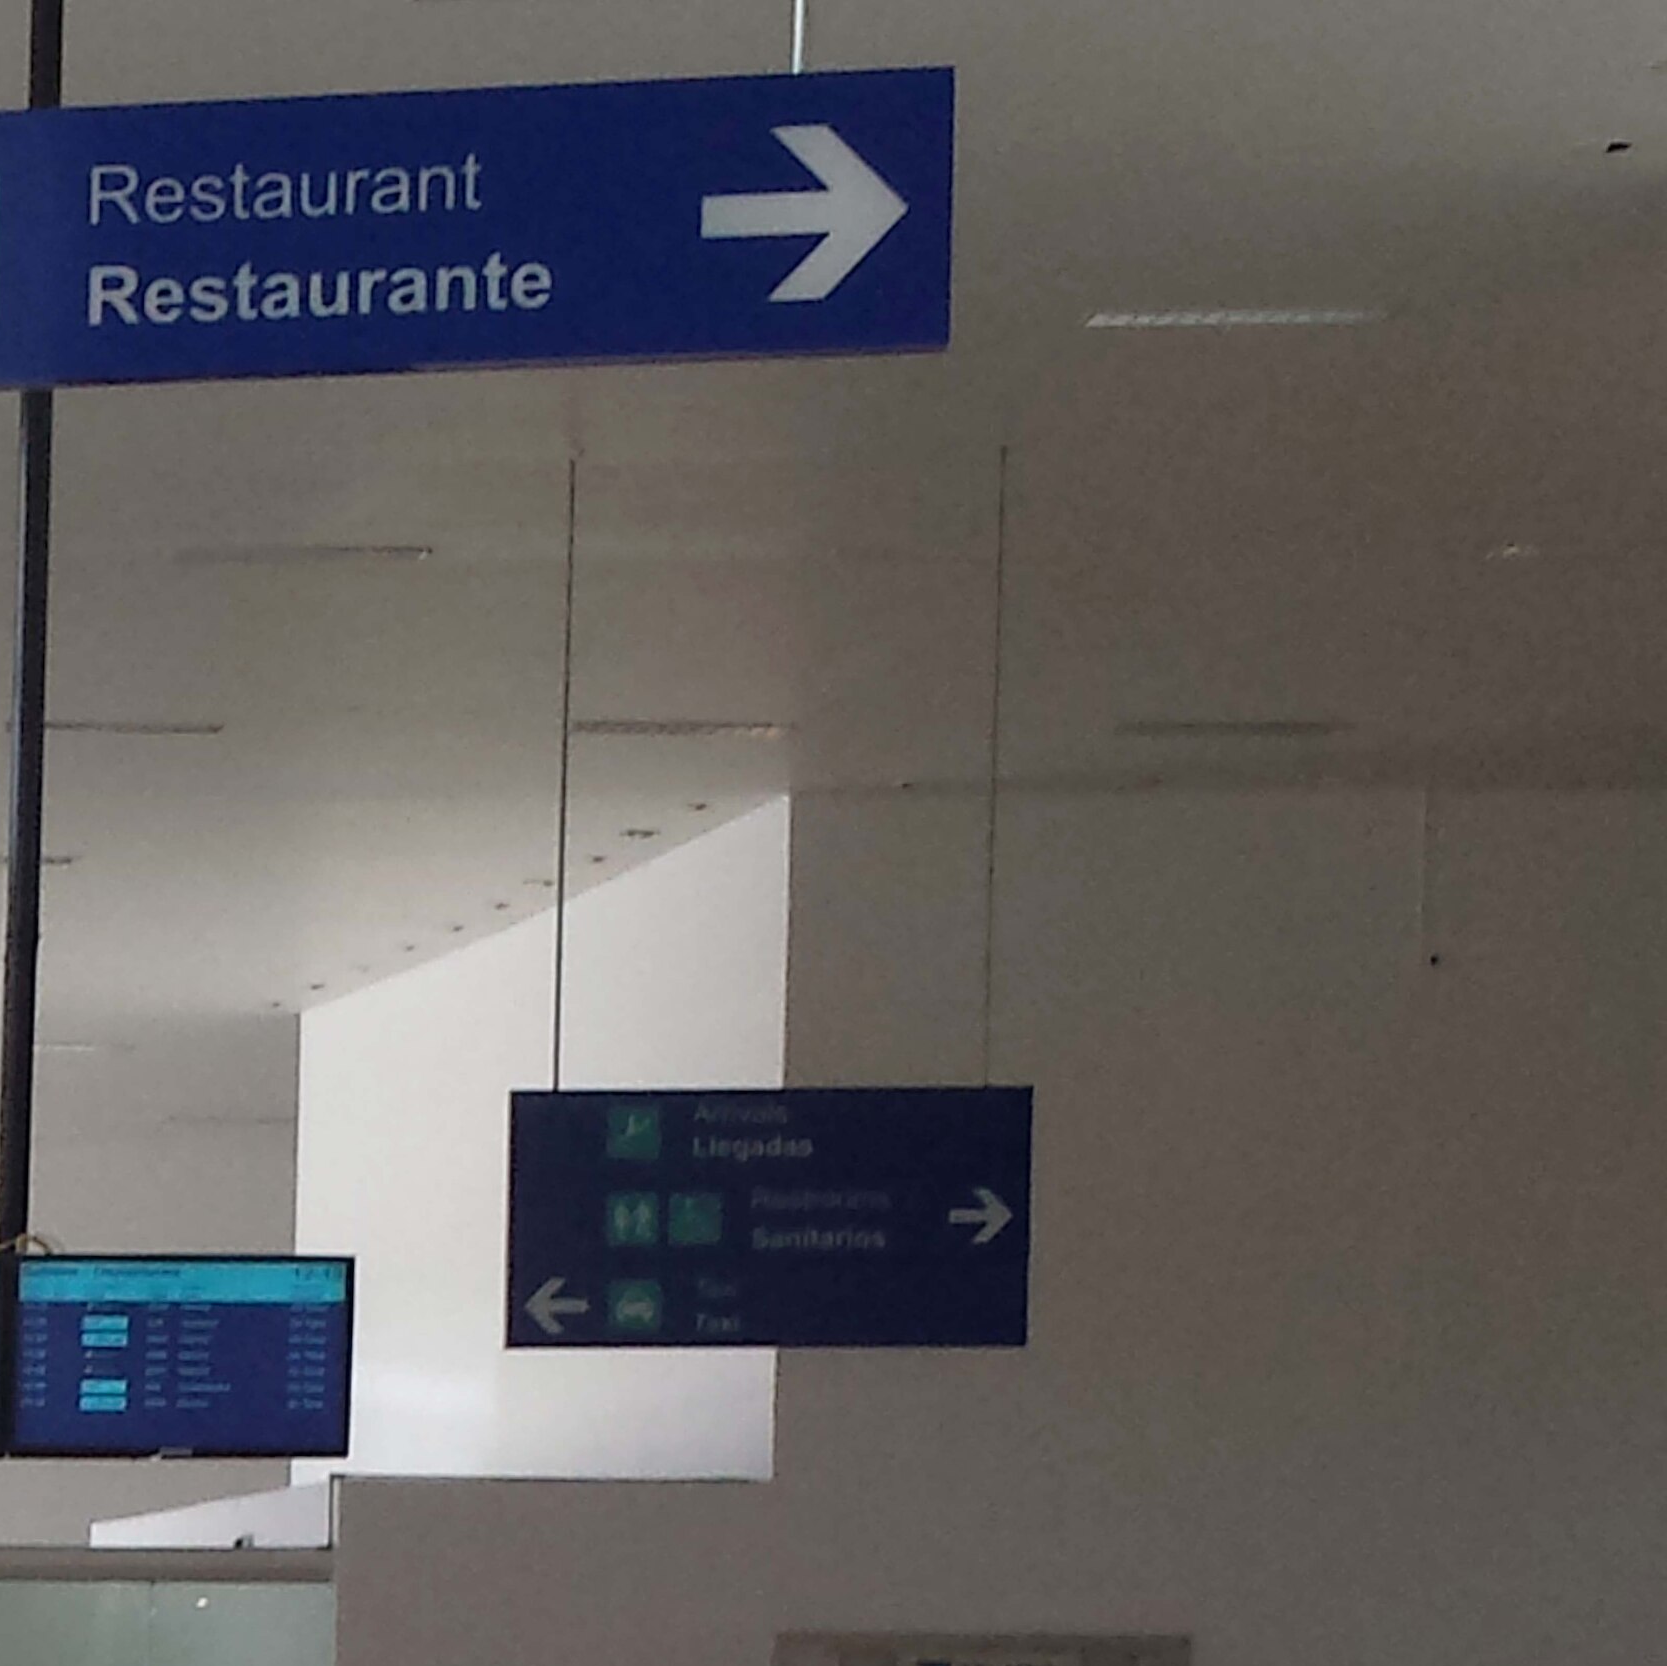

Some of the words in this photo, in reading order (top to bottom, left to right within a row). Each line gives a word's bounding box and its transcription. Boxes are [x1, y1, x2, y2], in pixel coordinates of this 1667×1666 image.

[88, 153, 484, 227] Restaurant
[87, 251, 554, 327] Restaurante
[692, 1136, 814, 1162] Llegadas
